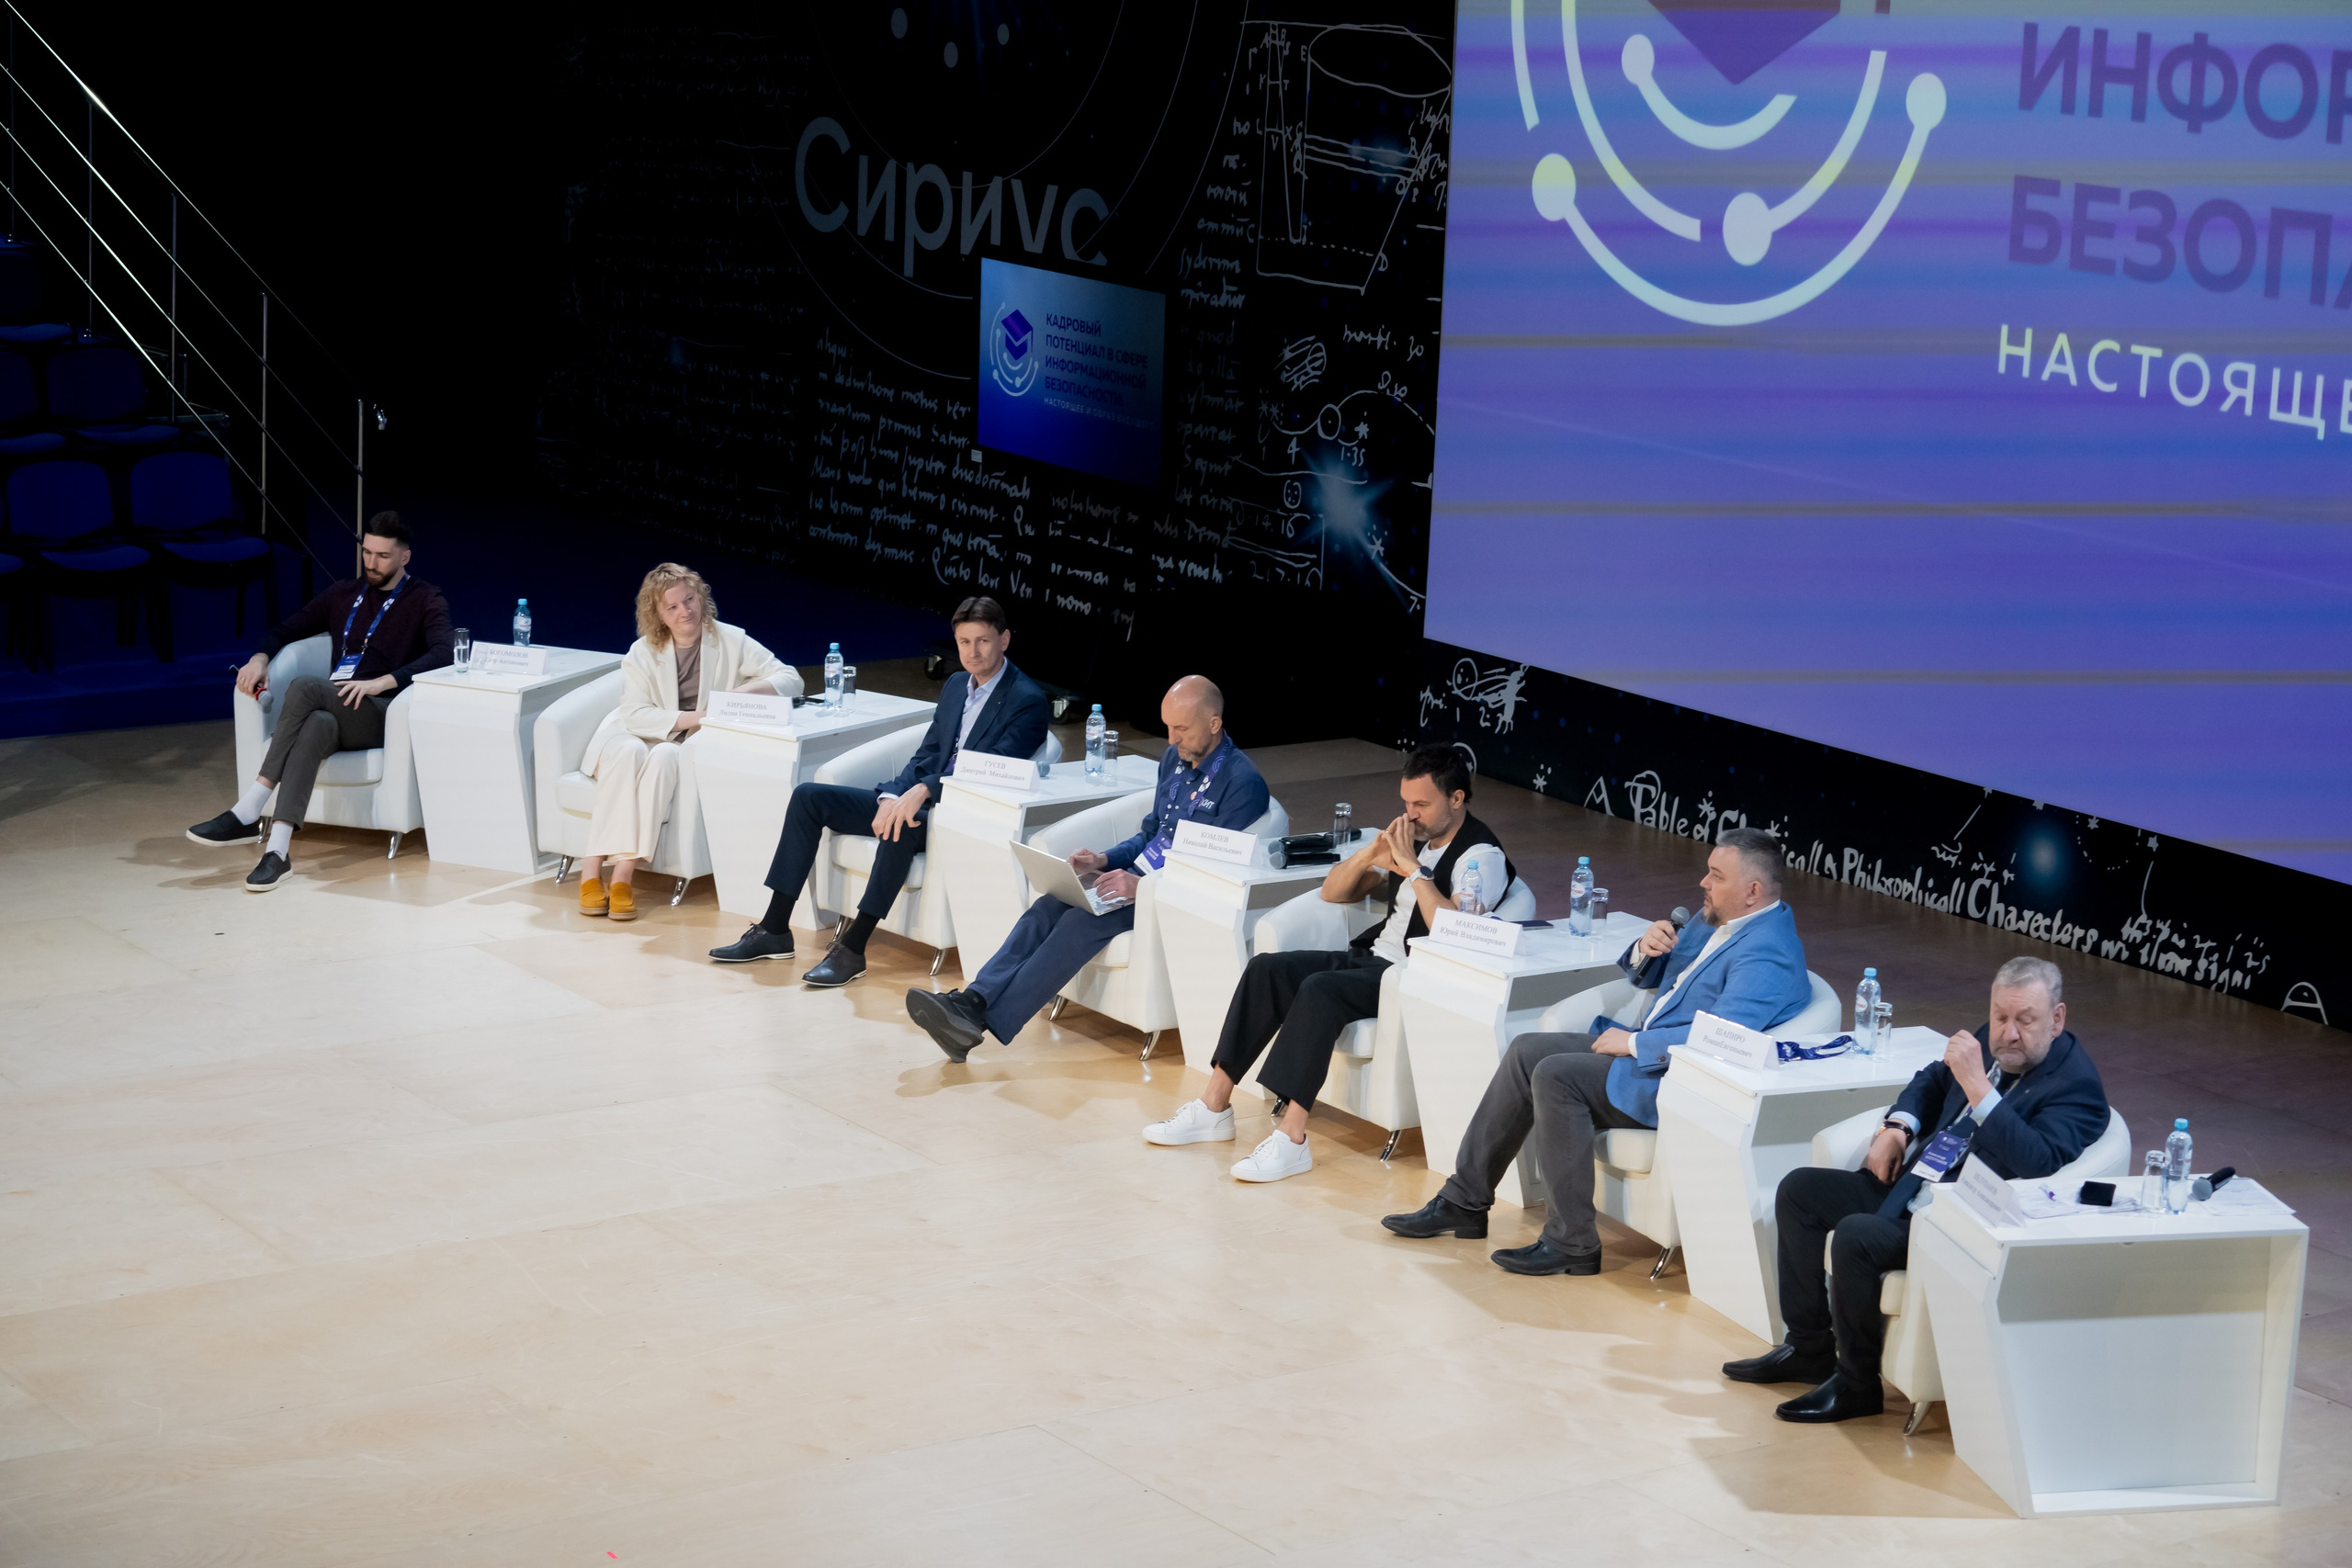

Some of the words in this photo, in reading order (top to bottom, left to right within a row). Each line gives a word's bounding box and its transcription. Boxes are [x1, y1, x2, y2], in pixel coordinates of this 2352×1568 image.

[1046, 312, 1102, 337] КАДРОВЫЙ
[1046, 333, 1105, 357] ПОТЕНЦИАЛ
[1106, 347, 1114, 361] В
[1114, 348, 1148, 369] СФЕРЕ
[1045, 355, 1147, 390] ИНФОРМАЦИОННОЙ
[1044, 396, 1084, 414] НАСТОЯЩЕЕ
[489, 649, 528, 659] БОГОМОЛОВ
[727, 701, 767, 710] КИРЬЯНОВА
[960, 766, 987, 776] Дмитрий
[989, 770, 1025, 782] Михайлович
[984, 761, 1007, 770] ГУСЕВ
[1583, 775, 1616, 817] A
[1200, 831, 1229, 843] КОМЛЕВ
[1182, 838, 1208, 849] Николай
[1208, 842, 1243, 856] Васильевич
[1454, 919, 1498, 934] МАКСИМОВ
[1440, 926, 1459, 937] Юрий
[1460, 931, 1507, 947] Владимирович
[1714, 1027, 1746, 1043] ШАПИРО
